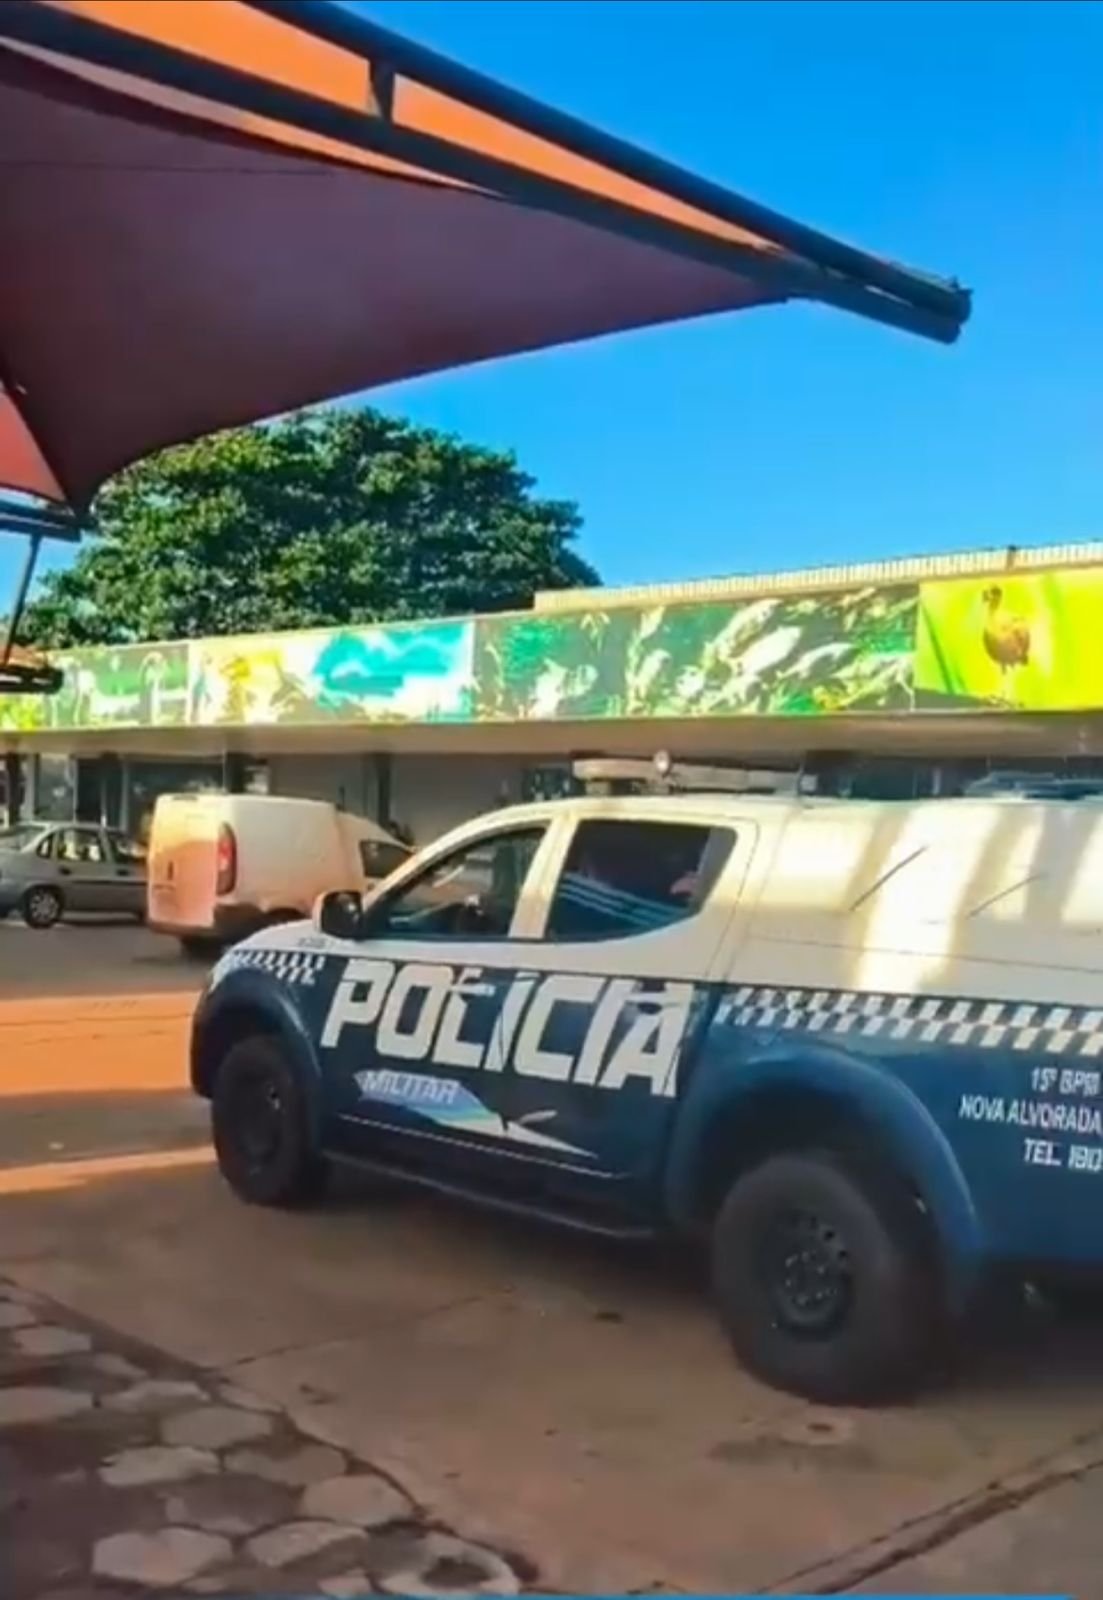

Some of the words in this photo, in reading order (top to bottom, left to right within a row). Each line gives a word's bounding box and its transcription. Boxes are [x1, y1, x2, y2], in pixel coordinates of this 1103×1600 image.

[361, 1069, 460, 1104] MILITAR
[959, 1094, 1005, 1122] NOVA
[1006, 1098, 1103, 1136] ALVORADA
